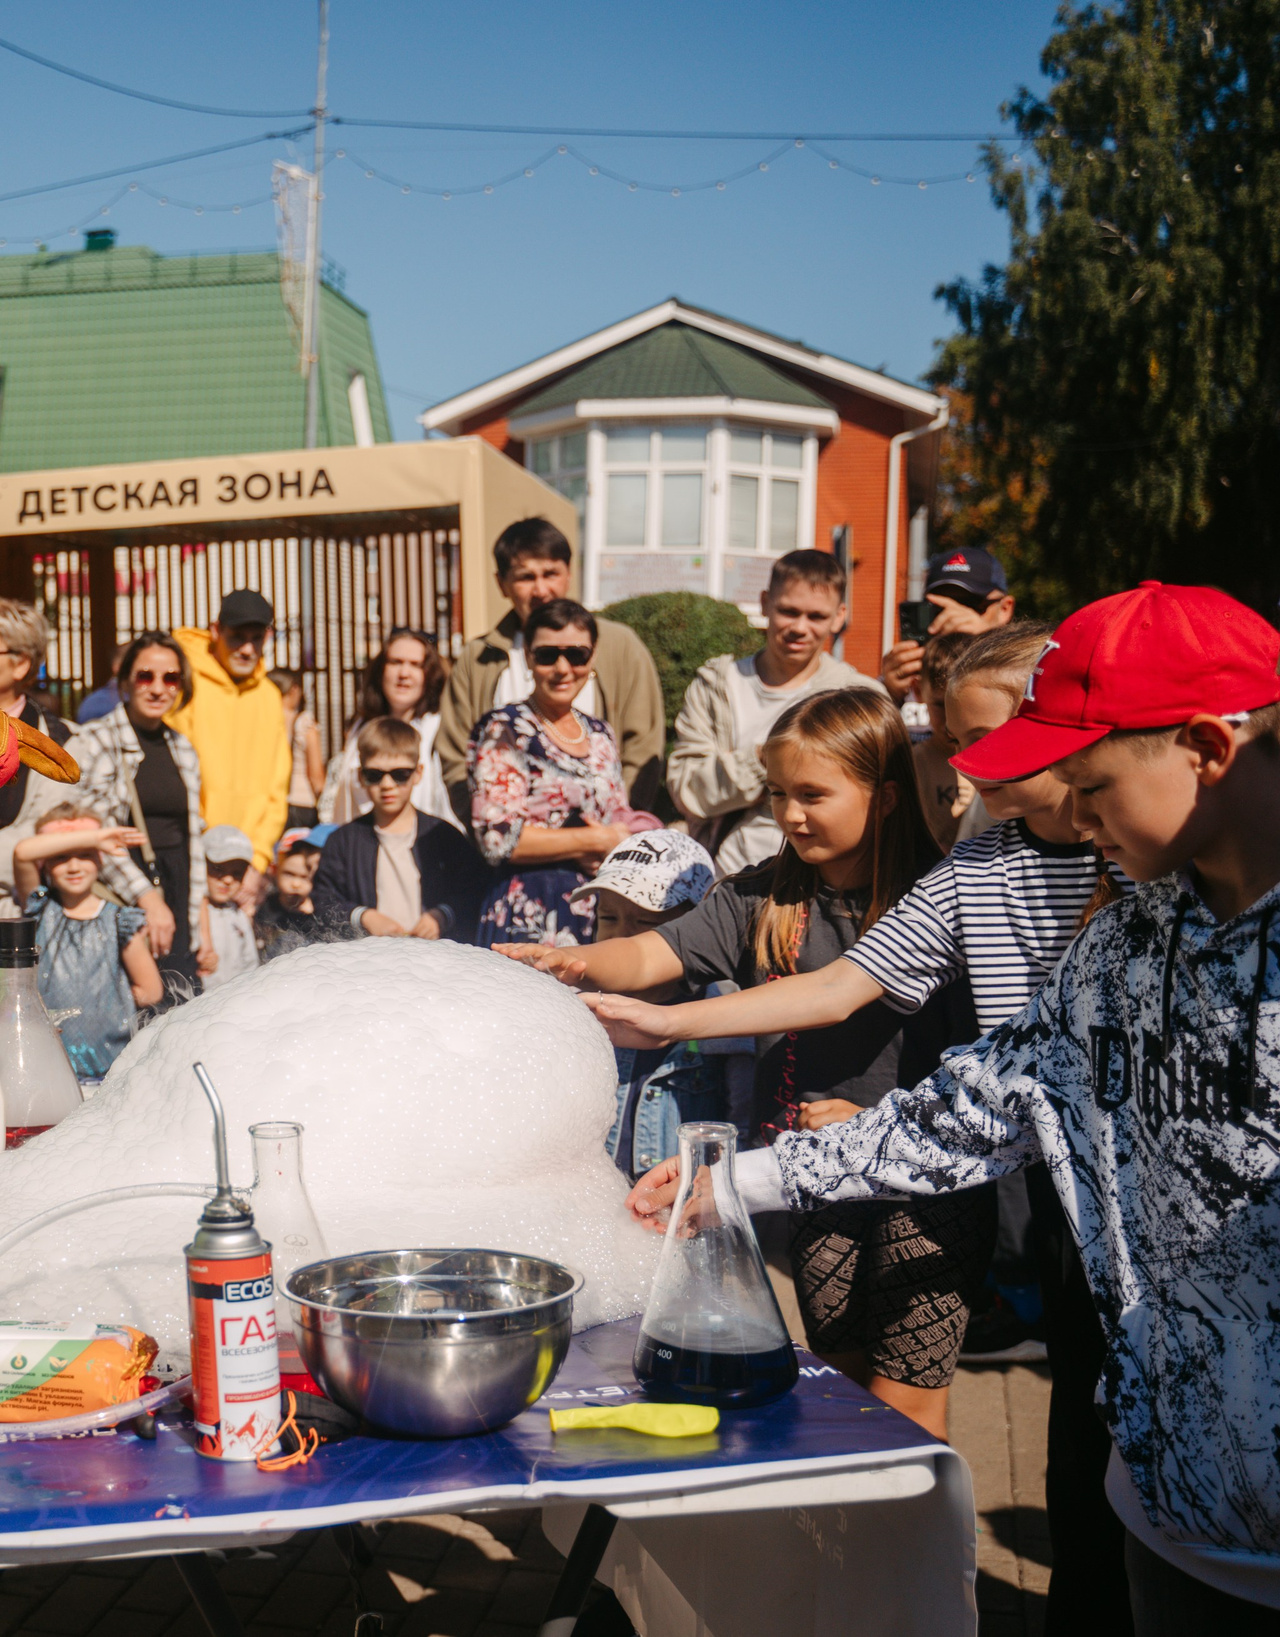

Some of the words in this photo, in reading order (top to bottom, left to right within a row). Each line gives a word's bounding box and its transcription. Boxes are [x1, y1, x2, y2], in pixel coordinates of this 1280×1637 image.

[18, 477, 199, 523] ДЕТСКАЯ
[217, 468, 335, 504] ЗОНА
[608, 849, 652, 865] PUMA
[656, 1348, 672, 1360] 400
